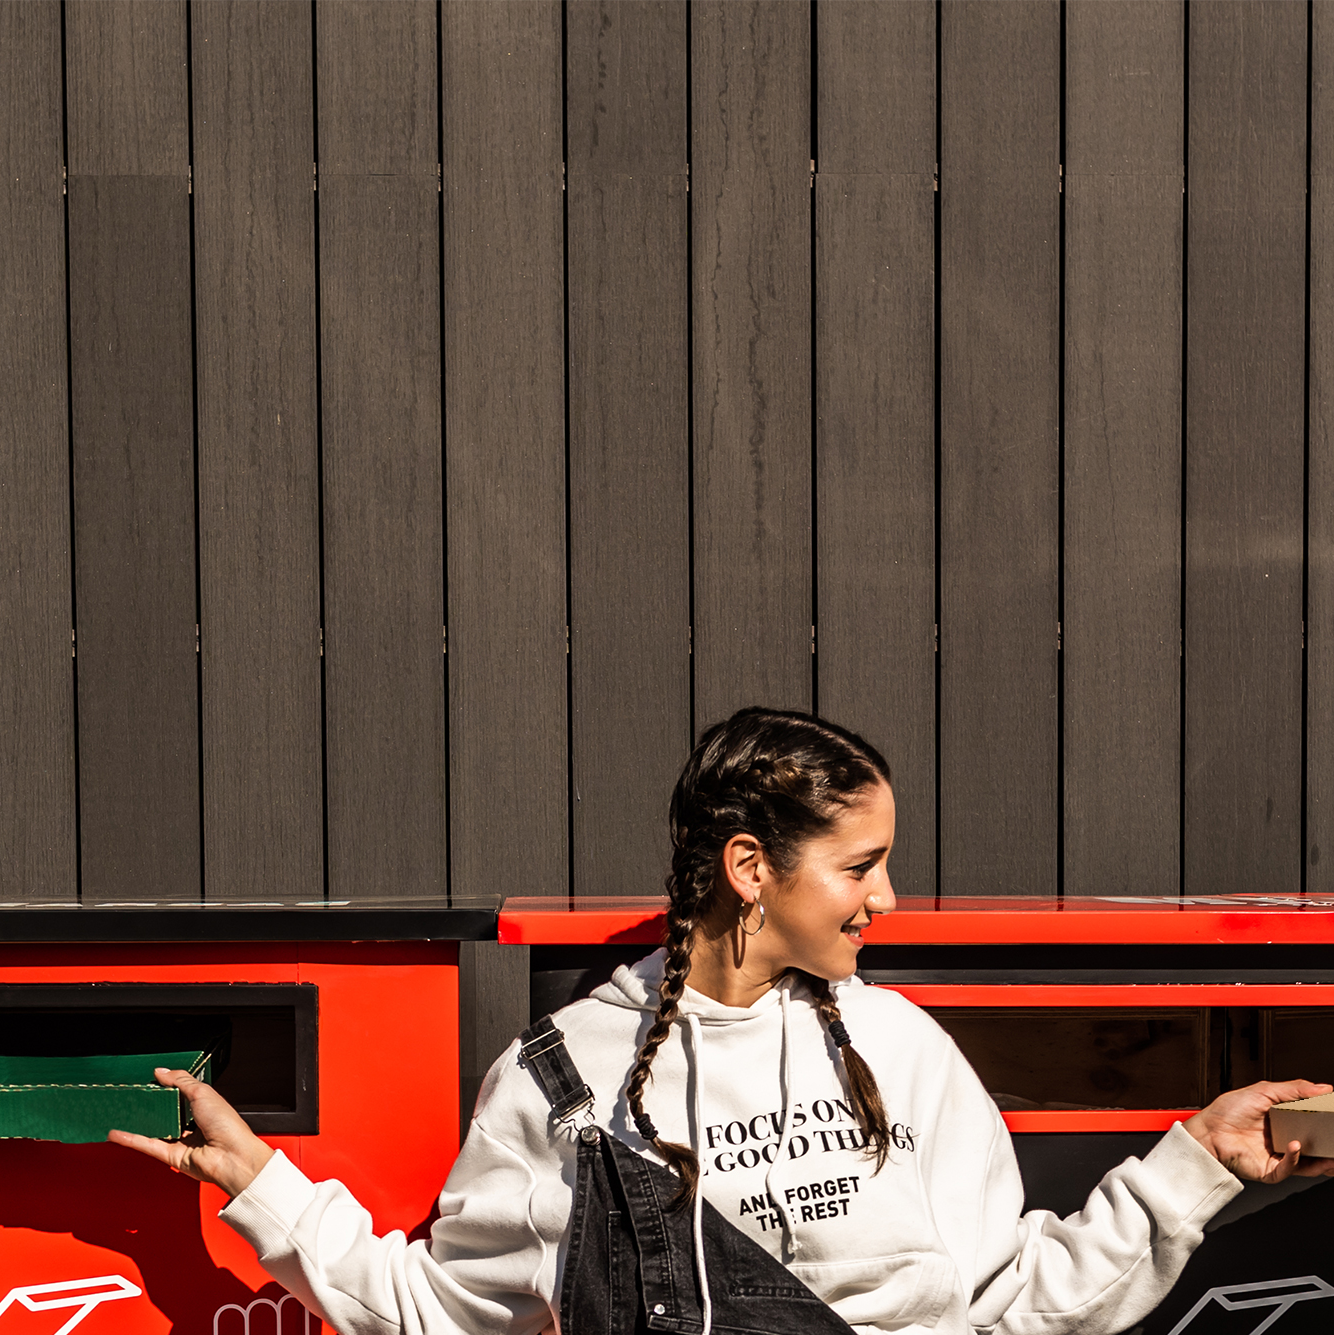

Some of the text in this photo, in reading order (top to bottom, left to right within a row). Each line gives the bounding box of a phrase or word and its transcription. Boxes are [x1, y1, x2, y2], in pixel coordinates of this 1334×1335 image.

[706, 1103, 807, 1150] FOCUS
[714, 1135, 810, 1172] GOOD
[813, 1123, 915, 1153] THIGS
[784, 1176, 860, 1205] FORGET
[756, 1198, 850, 1232] TH REST
